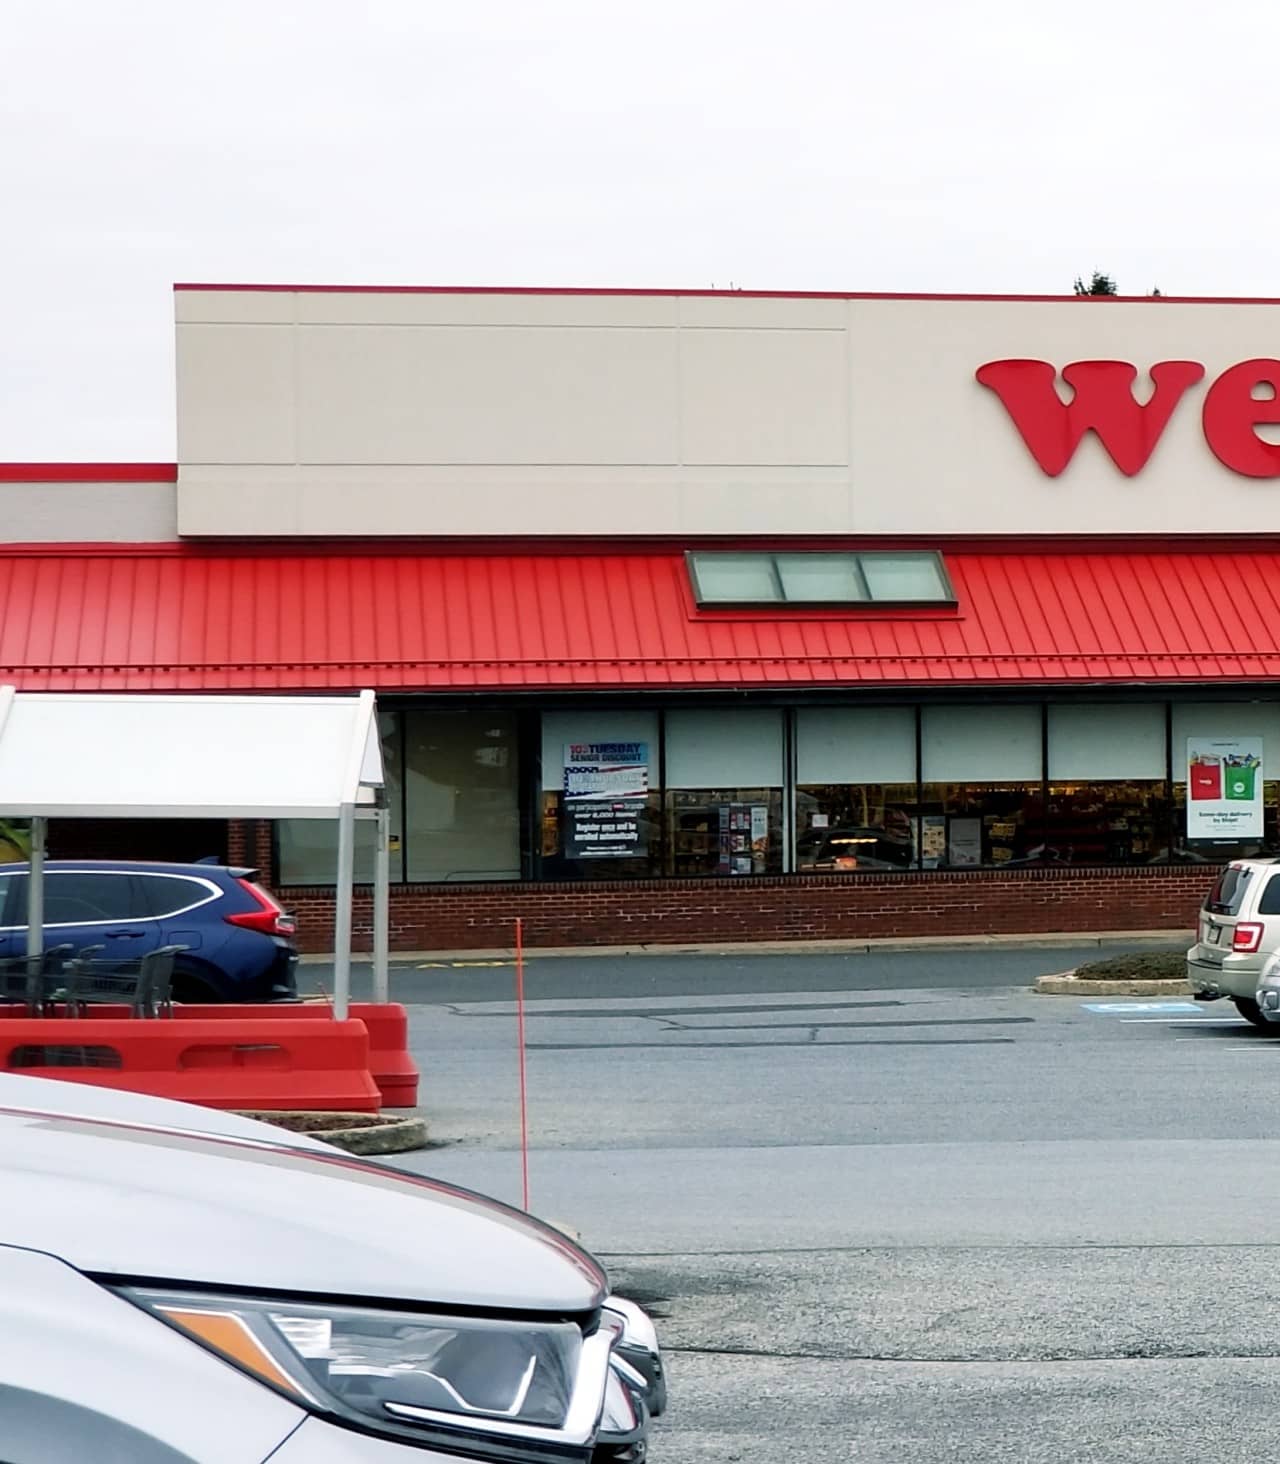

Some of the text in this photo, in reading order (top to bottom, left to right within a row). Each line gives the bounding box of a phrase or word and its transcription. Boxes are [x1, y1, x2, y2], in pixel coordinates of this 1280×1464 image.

[588, 743, 641, 754] TUESDAY
[570, 753, 642, 762] SENIOR DISCOUNT
